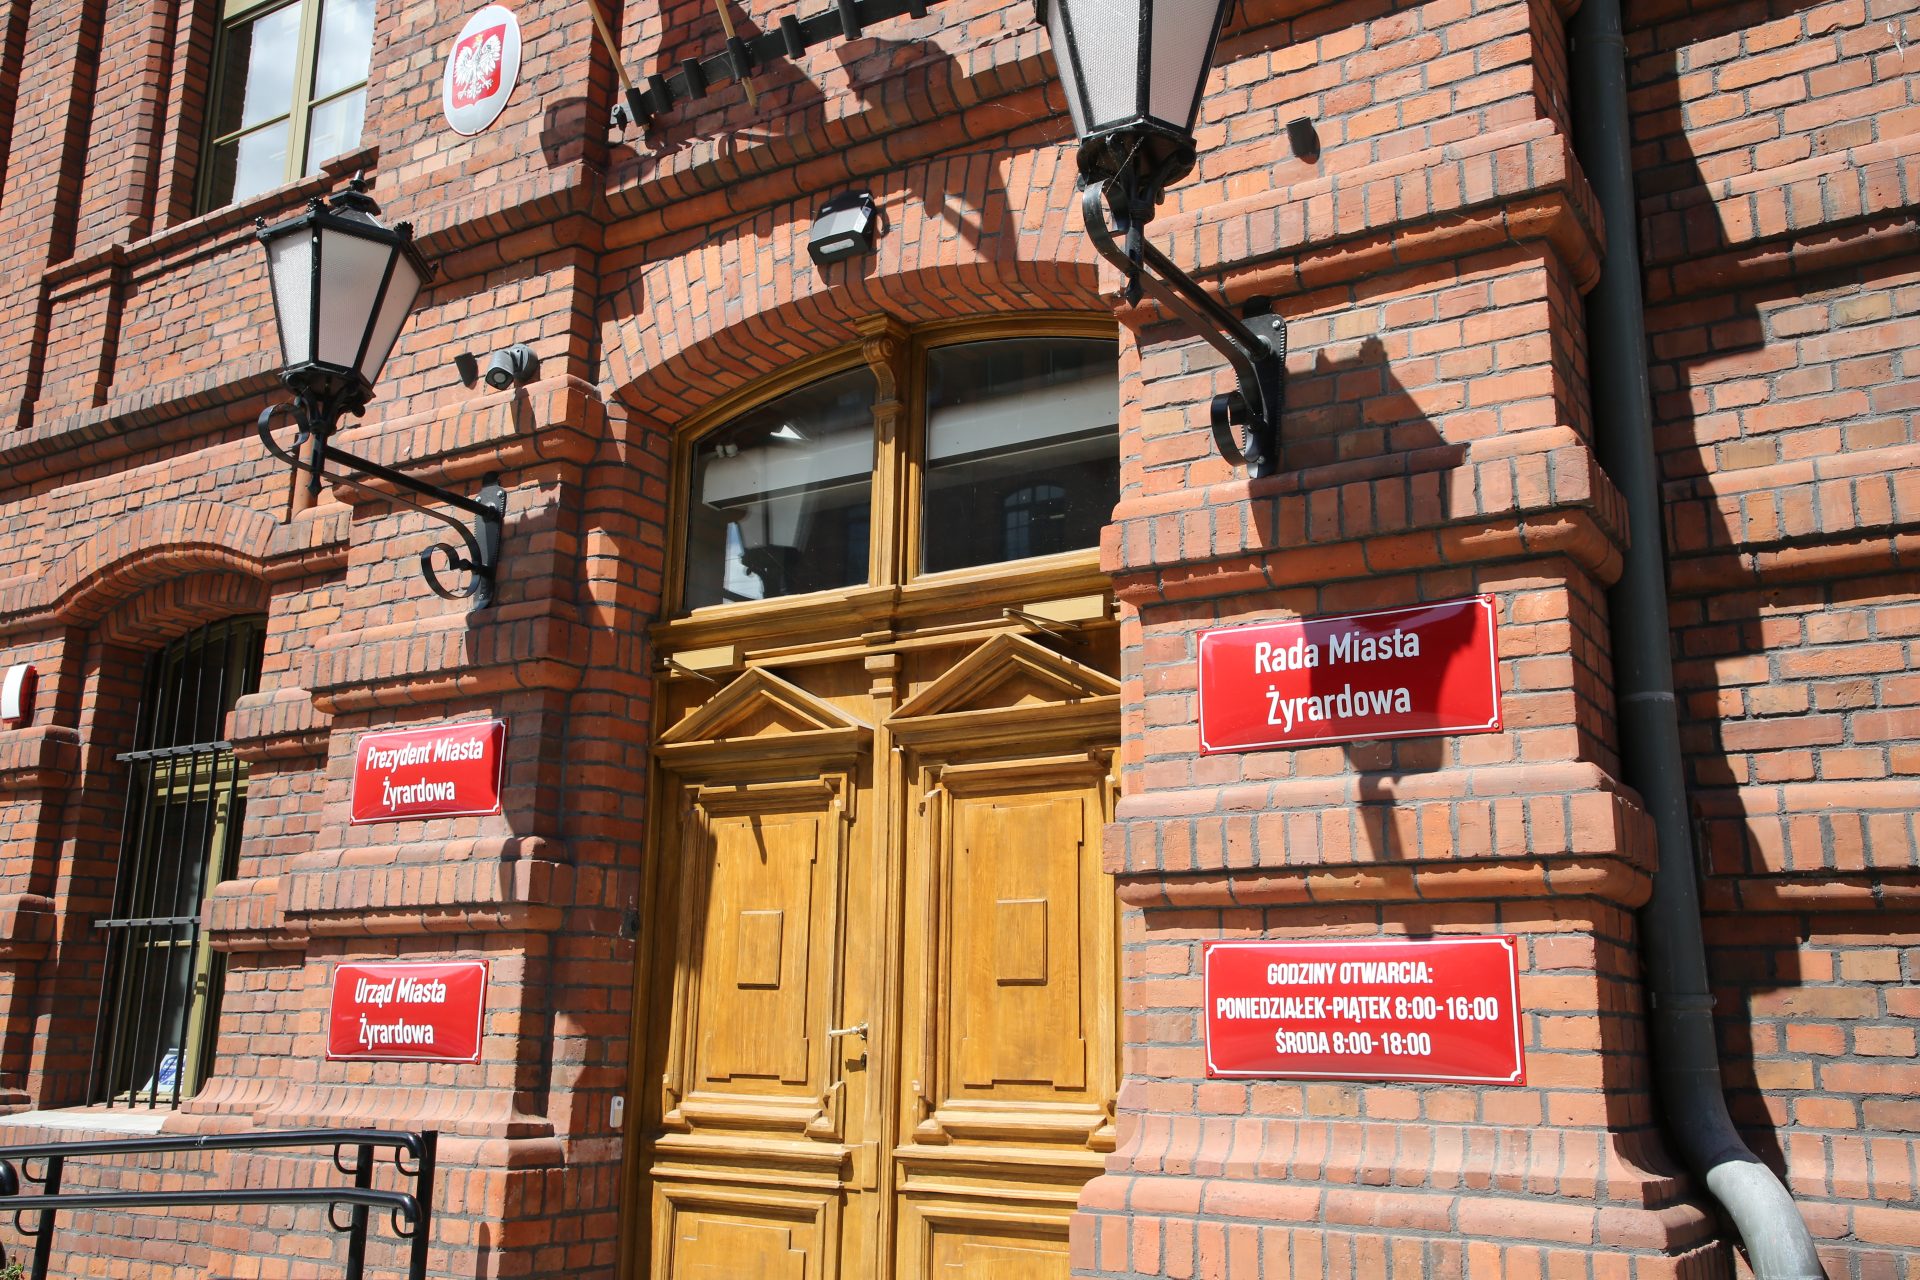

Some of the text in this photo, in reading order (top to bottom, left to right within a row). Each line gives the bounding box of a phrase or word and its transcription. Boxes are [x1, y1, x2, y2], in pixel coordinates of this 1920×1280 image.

[1255, 628, 1420, 674] Rada Miasta
[1265, 683, 1412, 733] Żyrardowa
[366, 737, 484, 773] Prezydent Miasta
[382, 776, 456, 811] Żyrardowa
[1267, 962, 1433, 985] GODZINY OTWARCIA:
[354, 977, 446, 1008] Urząd Miasta
[1217, 996, 1391, 1023] PONIEDZIAŁEK-PIĄTEK
[359, 1013, 434, 1050] Żyrardowa
[1275, 1027, 1330, 1054] ŚRODA
